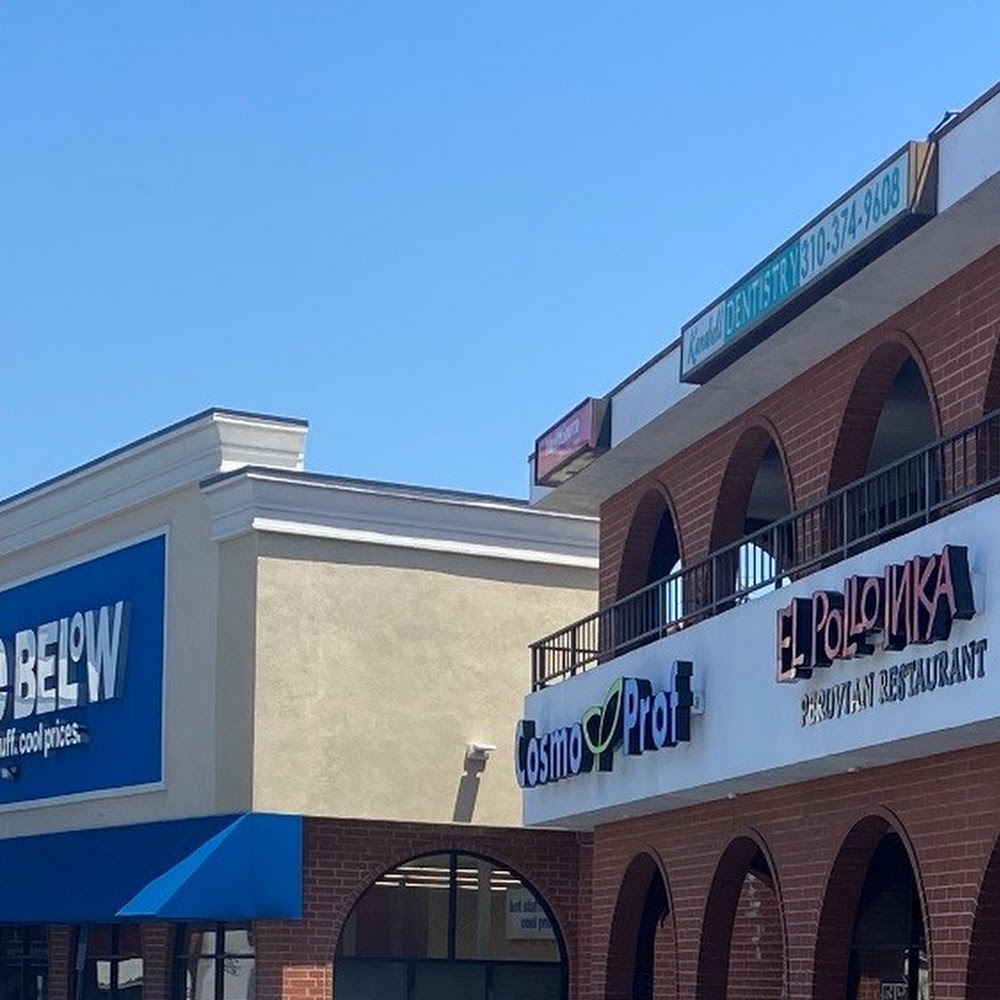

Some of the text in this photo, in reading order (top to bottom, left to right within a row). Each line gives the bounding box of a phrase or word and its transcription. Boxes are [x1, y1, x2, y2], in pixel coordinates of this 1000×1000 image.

[726, 242, 800, 336] DENTISTRY
[801, 166, 900, 280] 310-374-9608
[777, 597, 813, 684] EL
[884, 544, 976, 651] INKA
[19, 721, 43, 755] cool
[515, 660, 690, 788] Cosmo Prof
[801, 638, 988, 727] PERUVIAN RESTAURANT
